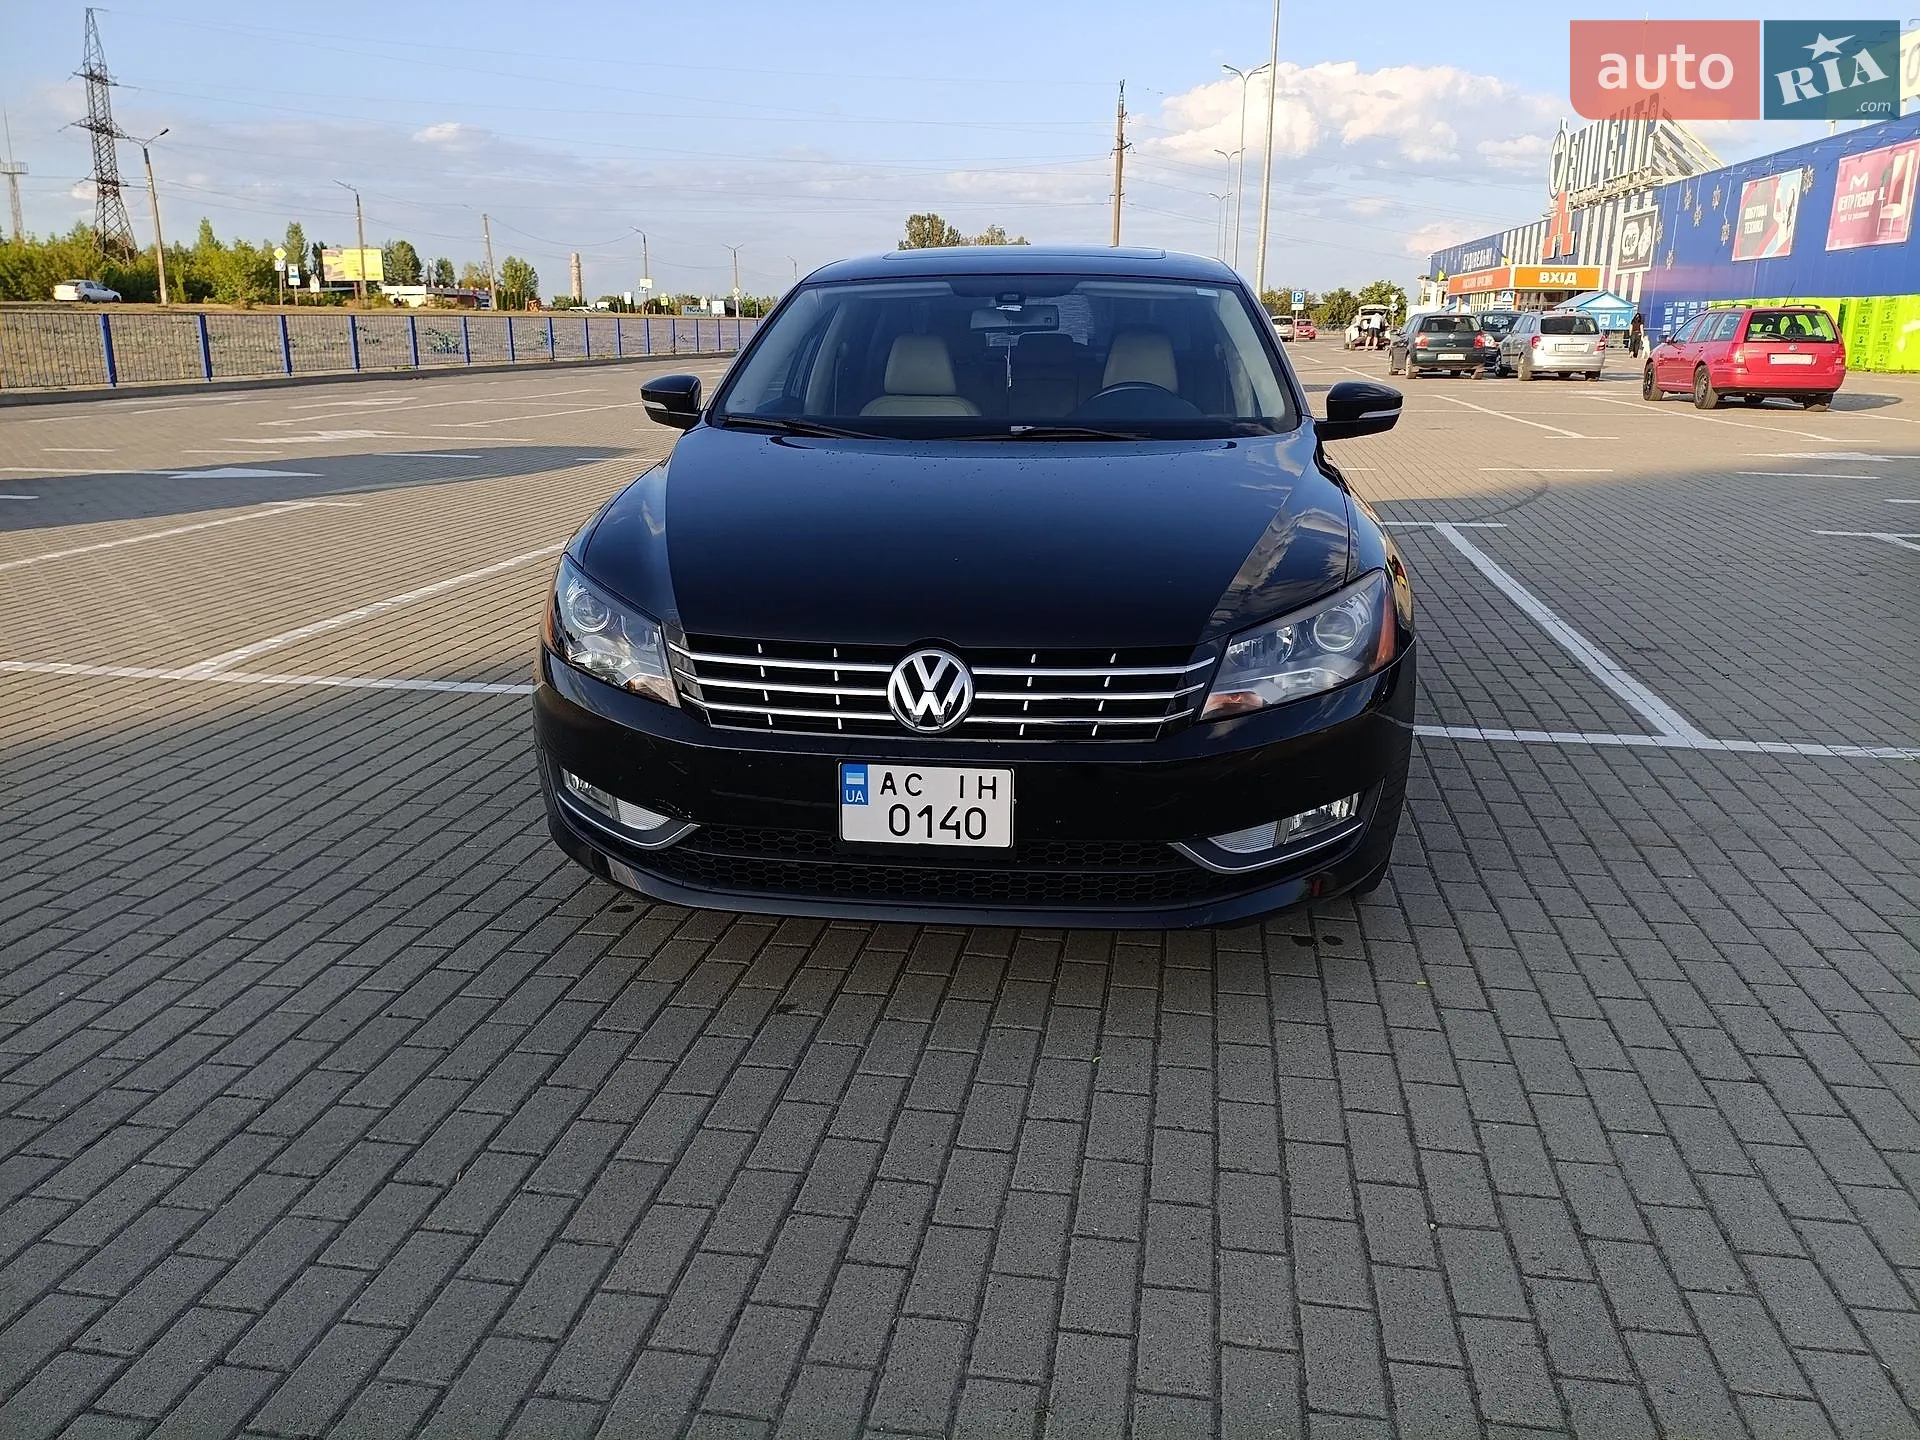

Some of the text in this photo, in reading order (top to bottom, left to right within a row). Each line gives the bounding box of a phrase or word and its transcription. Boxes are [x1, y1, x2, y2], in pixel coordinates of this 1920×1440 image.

[1538, 271, 1577, 286] ВХІД
[845, 790, 865, 803] UA
[880, 771, 997, 800] AC IH
[888, 803, 987, 840] 0140
